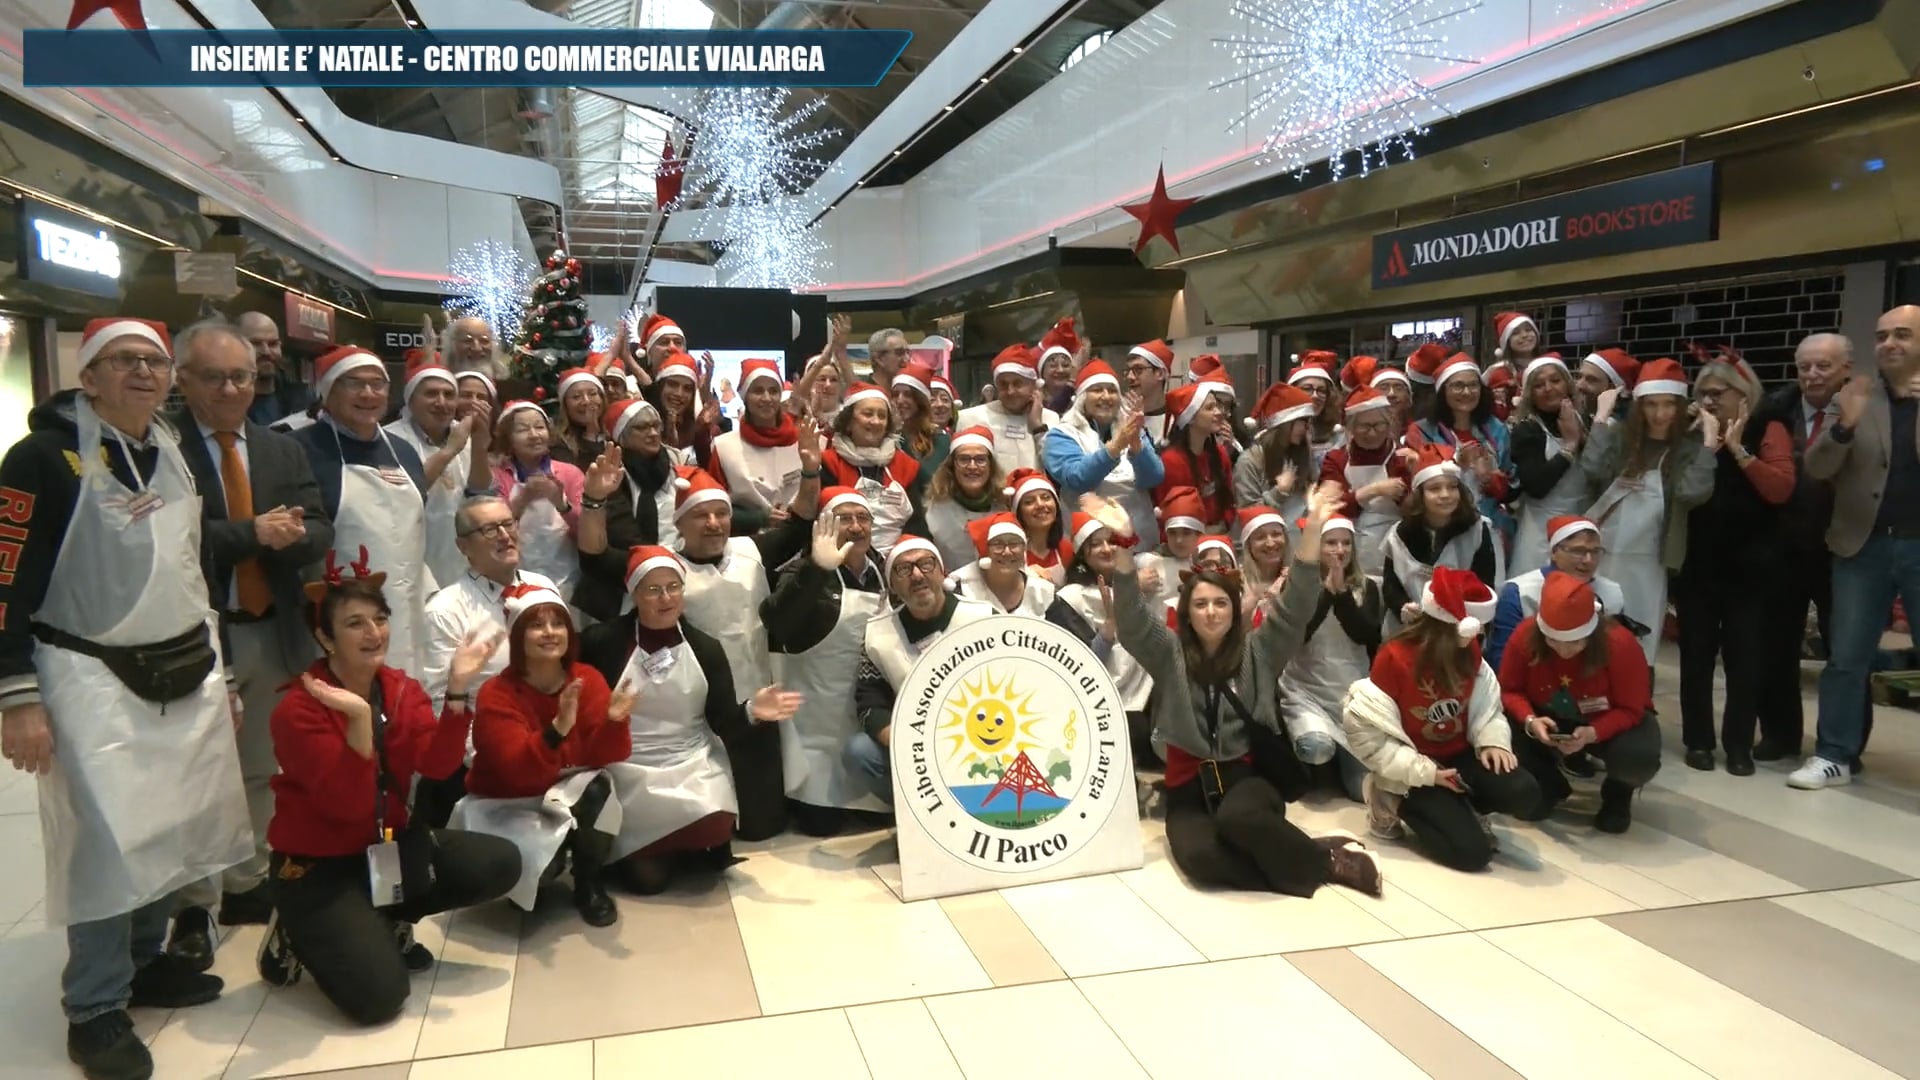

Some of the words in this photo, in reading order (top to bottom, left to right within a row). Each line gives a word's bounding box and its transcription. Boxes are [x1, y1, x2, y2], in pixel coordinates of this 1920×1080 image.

[1411, 216, 1562, 267] MONDADORI
[1565, 195, 1696, 241] BOOKSTORE
[1001, 630, 1084, 676] Cittadini
[909, 635, 996, 735] Associazione
[1080, 675, 1100, 696] di
[1094, 697, 1112, 733] Via
[912, 742, 943, 813] Libera
[1088, 740, 1115, 800] Larga
[966, 830, 991, 859] Il
[996, 832, 1068, 864] Parco
